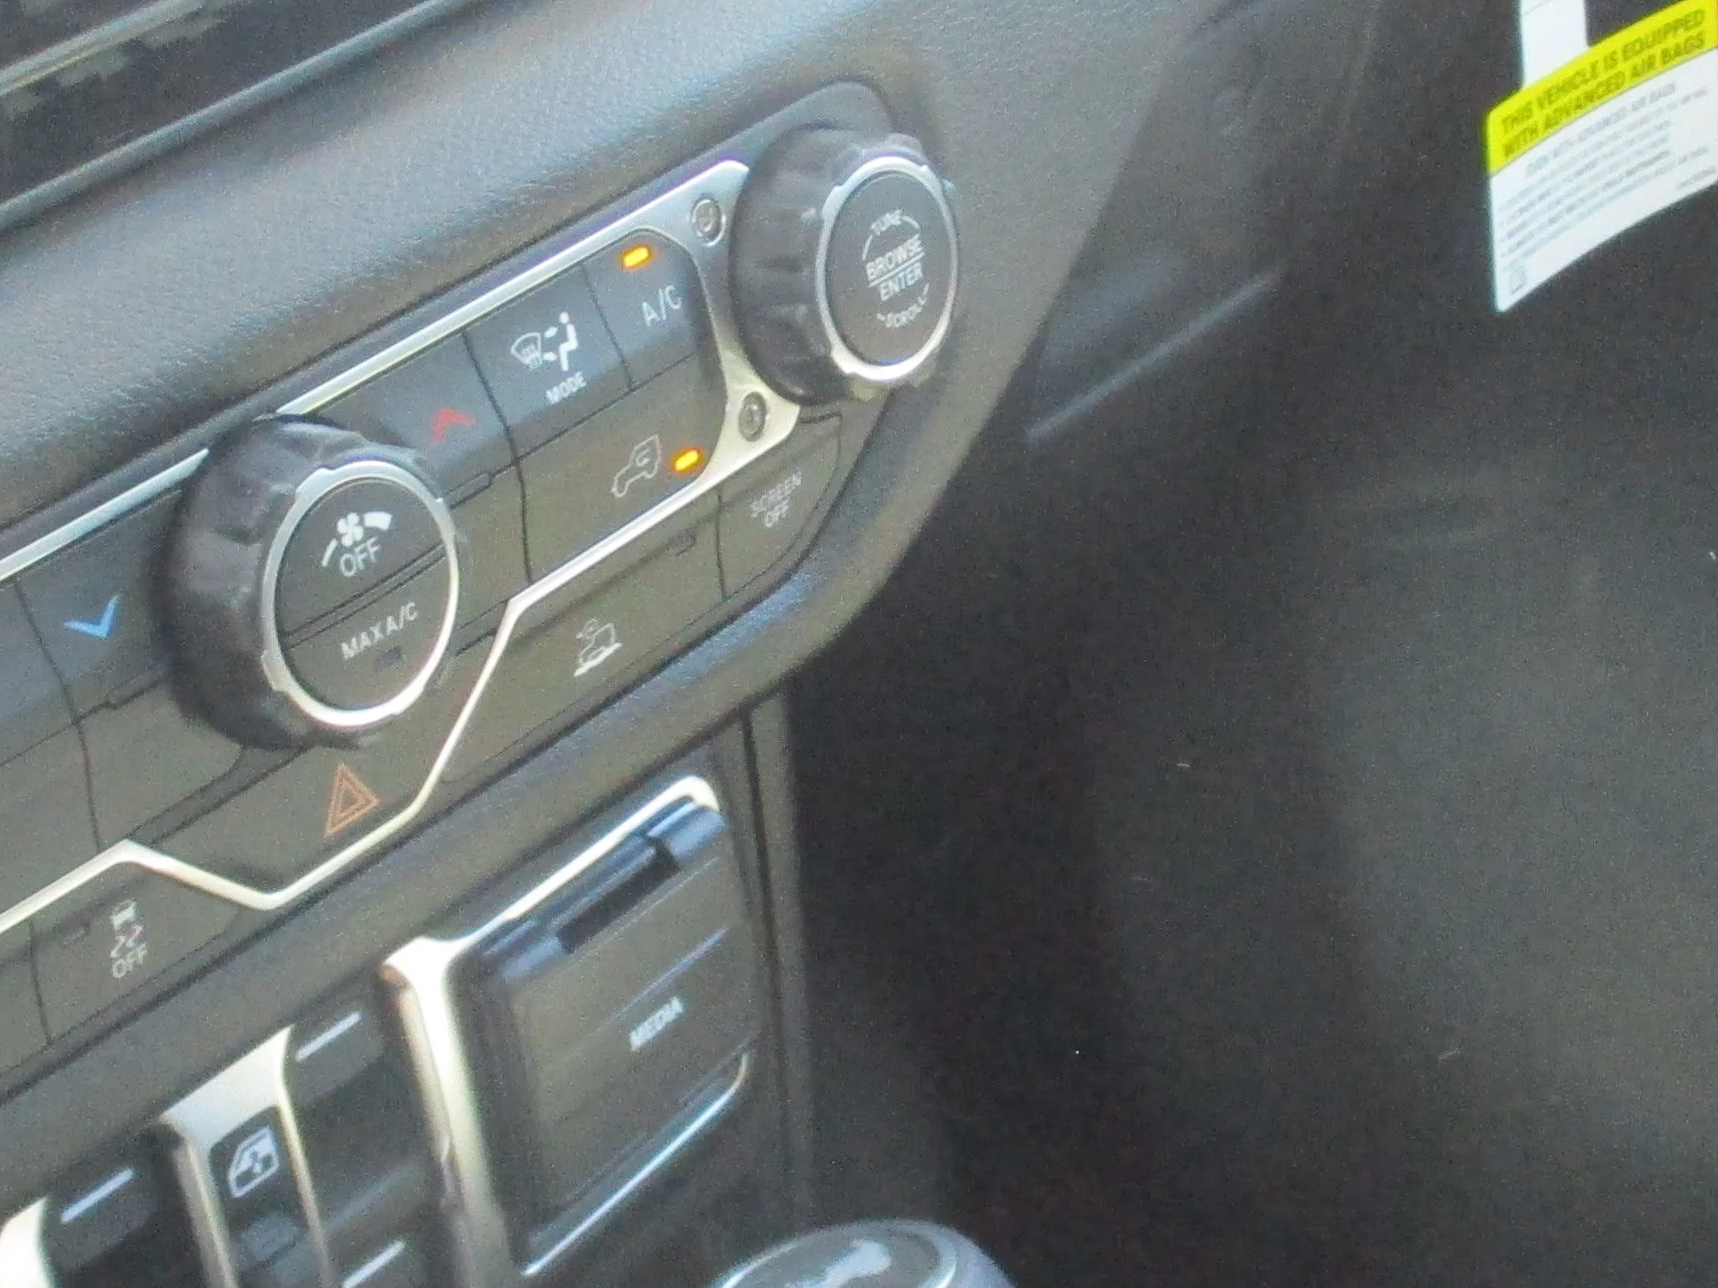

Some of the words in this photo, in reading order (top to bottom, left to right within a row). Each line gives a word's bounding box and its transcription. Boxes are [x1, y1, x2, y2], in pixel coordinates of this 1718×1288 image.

[1537, 59, 1600, 109] VEHICLE
[1602, 49, 1620, 72] IS
[1620, 8, 1707, 63] EQUIPPED
[864, 232, 925, 282] BROWSE
[878, 262, 924, 301] ENTER
[641, 284, 683, 328] A/C
[545, 370, 588, 406] MODE
[765, 496, 790, 528] OFF
[339, 535, 382, 578] OFF
[339, 620, 385, 660] MAX
[385, 601, 419, 635] A/C
[111, 941, 148, 979] OFF
[629, 996, 684, 1052] MEDIA
